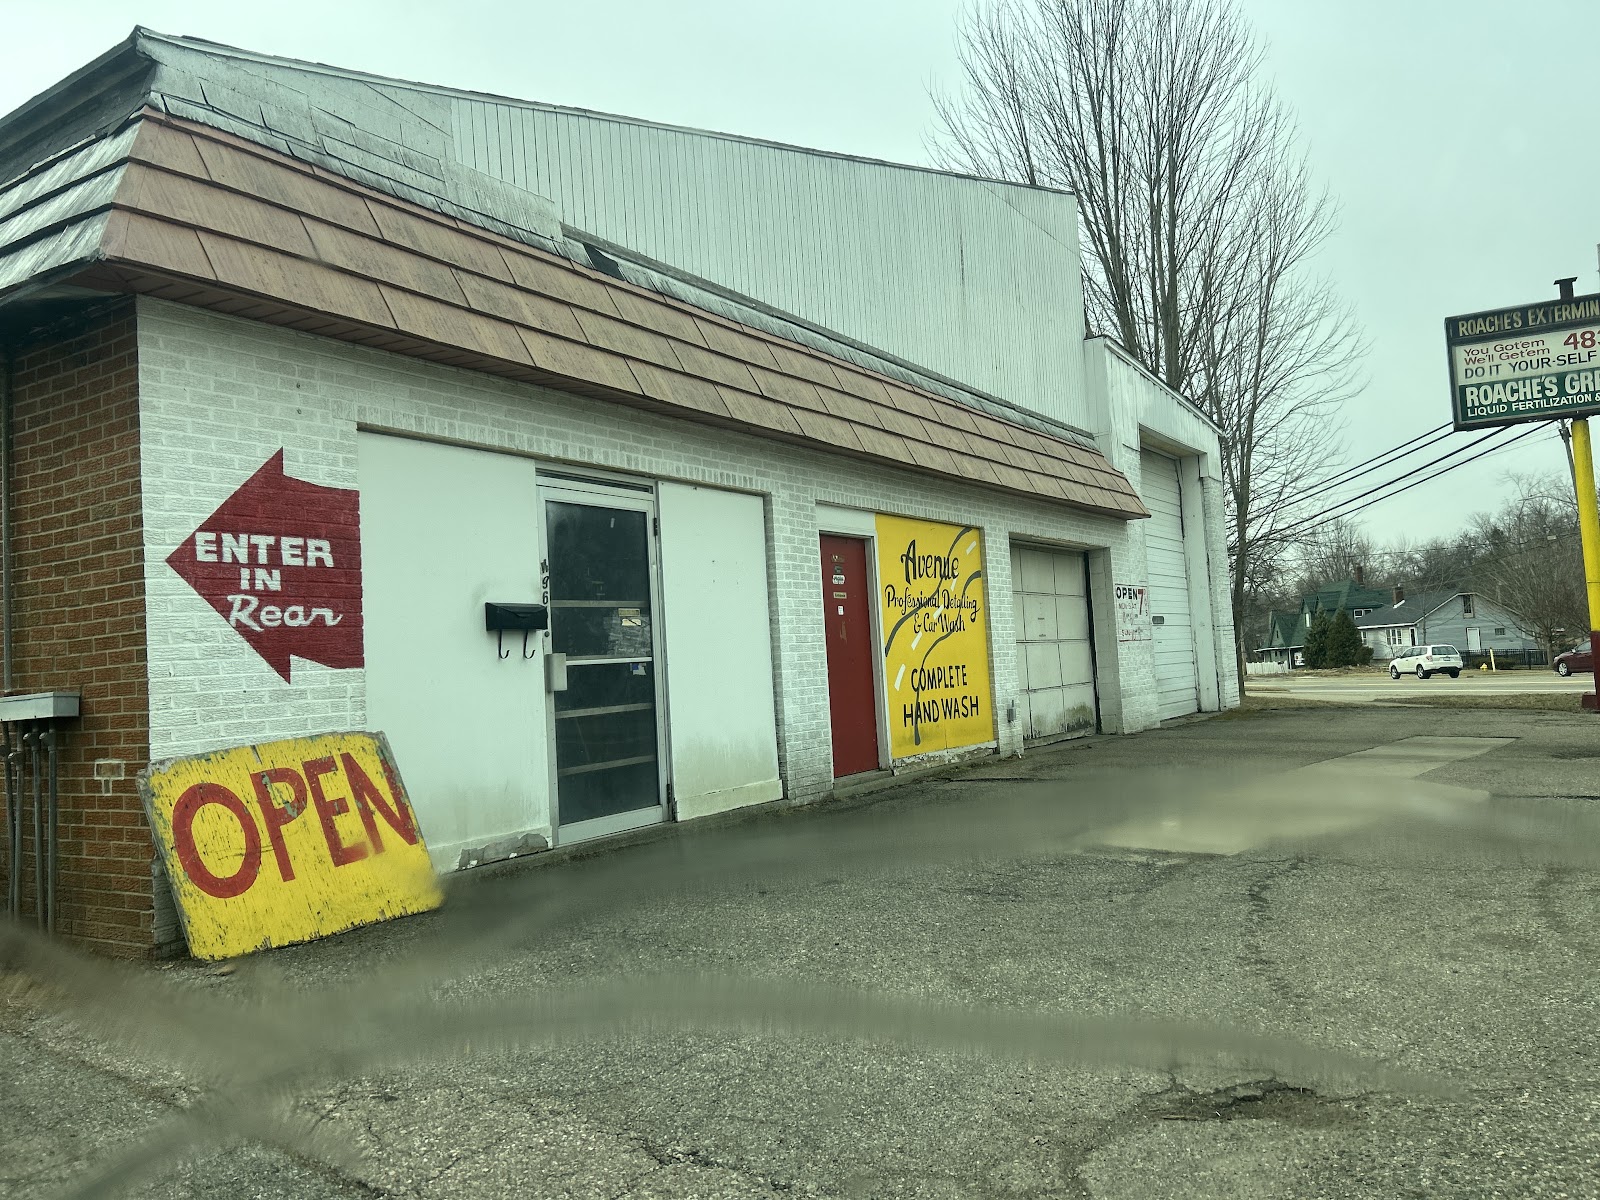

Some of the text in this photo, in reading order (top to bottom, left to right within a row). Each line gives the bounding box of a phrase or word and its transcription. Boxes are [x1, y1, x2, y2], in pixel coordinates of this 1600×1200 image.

[1459, 311, 1522, 336] ROACHE'S
[1464, 330, 1600, 356] You Got'em 48
[1464, 347, 1550, 365] We'll Get'em
[1465, 350, 1597, 379] DO IT YOUR-SELF
[1465, 376, 1558, 407] ROACHE'S
[1467, 404, 1507, 417] LIQUID
[1512, 393, 1592, 411] FERTILIZATION
[194, 531, 335, 568] ENTER
[900, 539, 959, 585] Avenue
[240, 567, 282, 591] IN
[226, 594, 343, 632] Rear
[884, 584, 981, 623] Professional Detailing
[1116, 587, 1144, 615] OPEN 7
[914, 612, 966, 634] & Car Wash
[911, 664, 967, 692] COMPLETE
[903, 695, 979, 727] HAND WASH
[172, 751, 418, 899] OPEN
